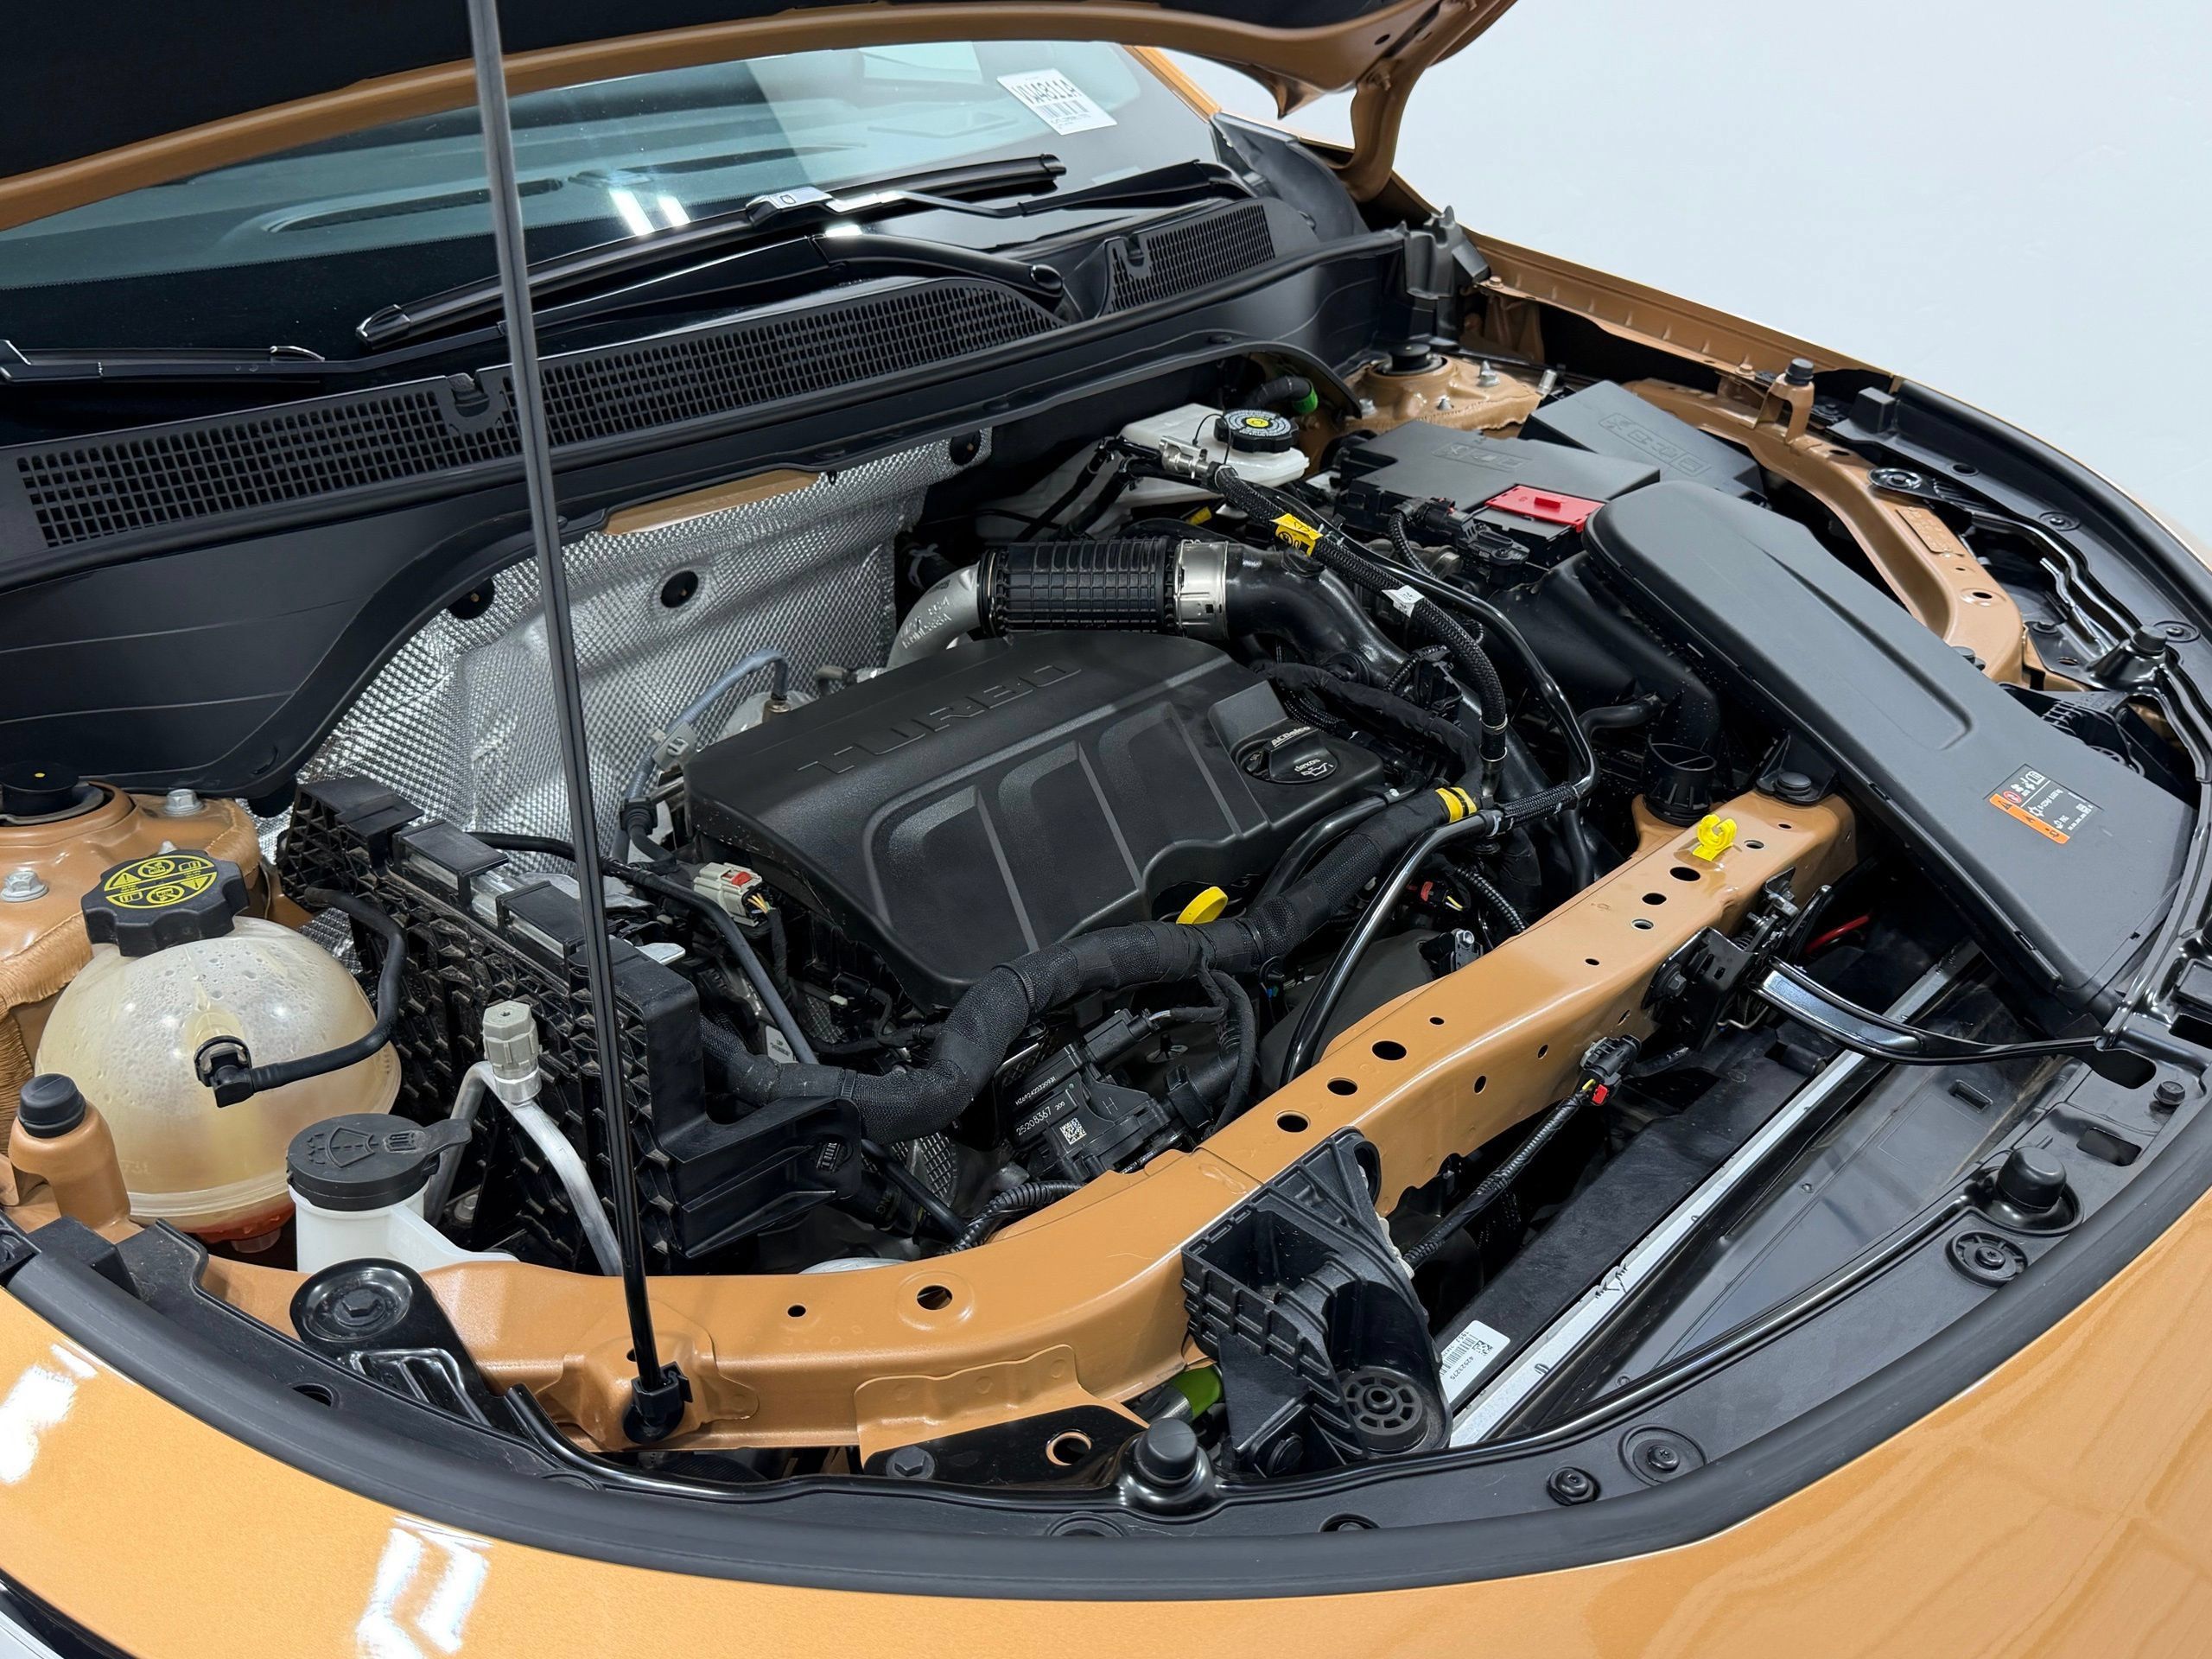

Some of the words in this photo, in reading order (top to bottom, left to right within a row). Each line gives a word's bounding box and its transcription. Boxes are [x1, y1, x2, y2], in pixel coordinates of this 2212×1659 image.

[797, 665, 1082, 774] TURBO
[1271, 726, 1311, 746] ACDelco
[1015, 1106, 1052, 1136] 25208367
